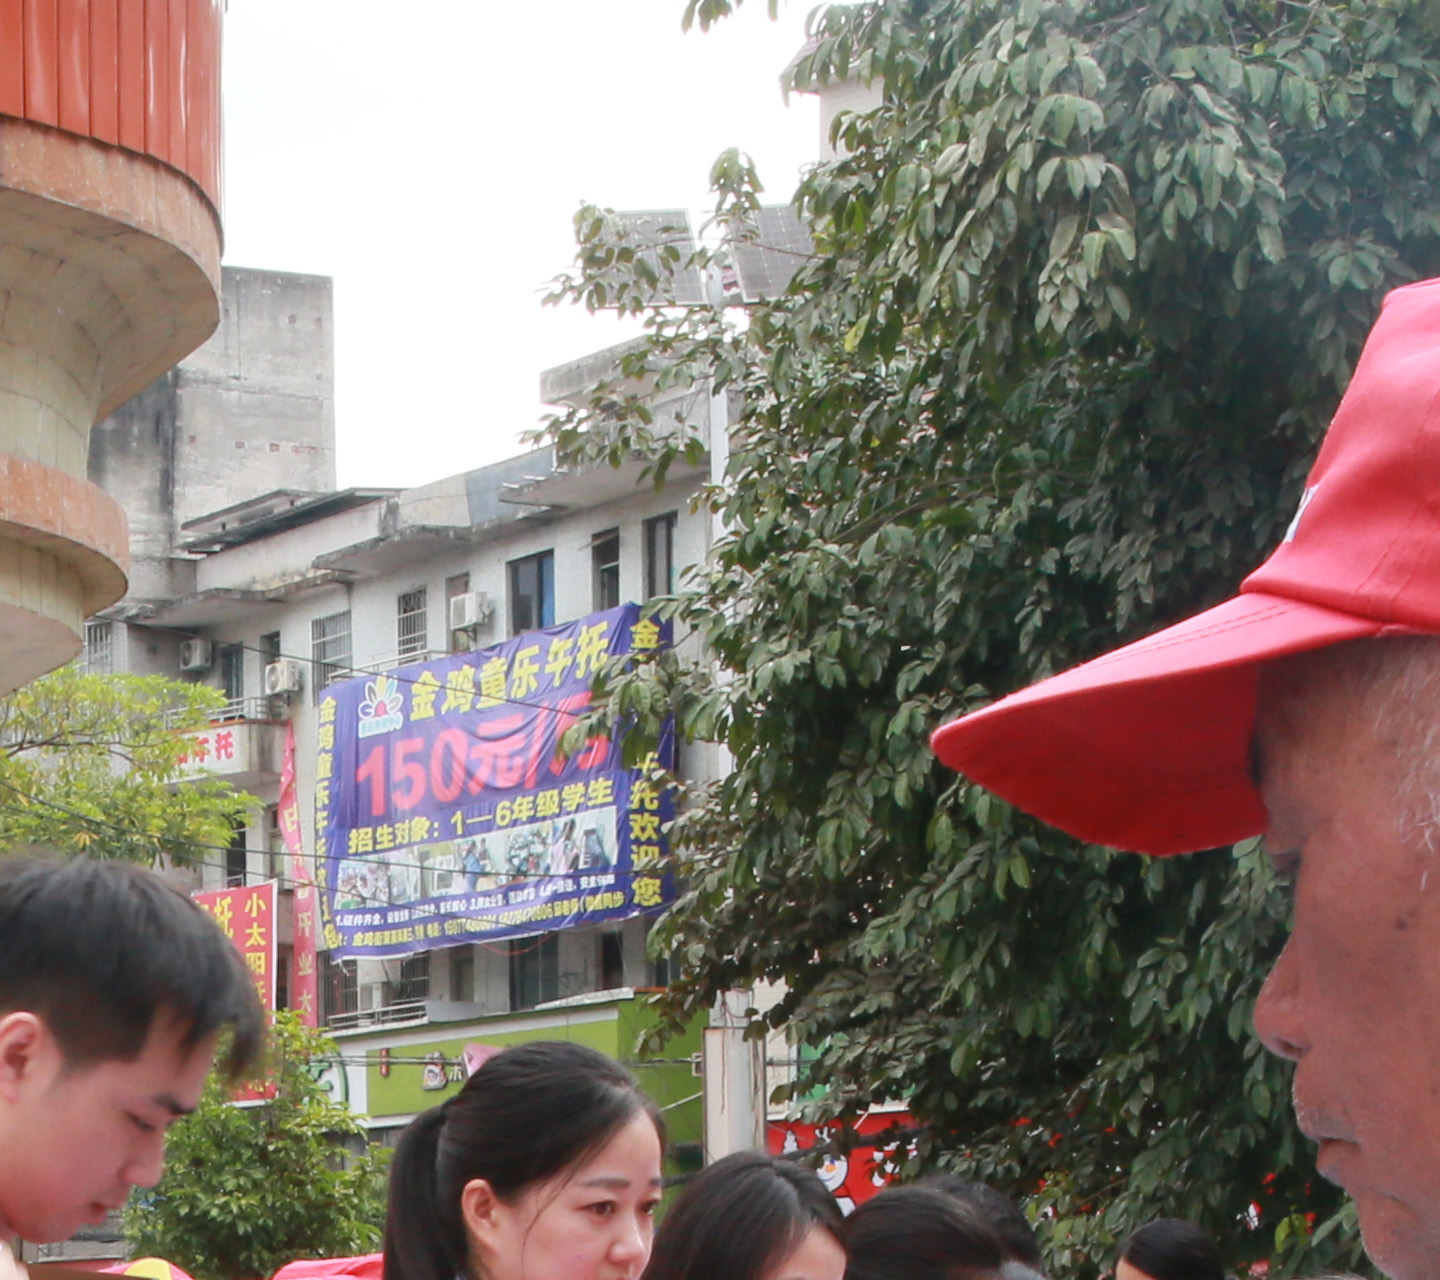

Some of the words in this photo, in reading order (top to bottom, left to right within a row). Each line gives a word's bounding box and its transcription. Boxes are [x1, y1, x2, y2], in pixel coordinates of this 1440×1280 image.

[409, 621, 610, 721] 金鸡童乐午托
